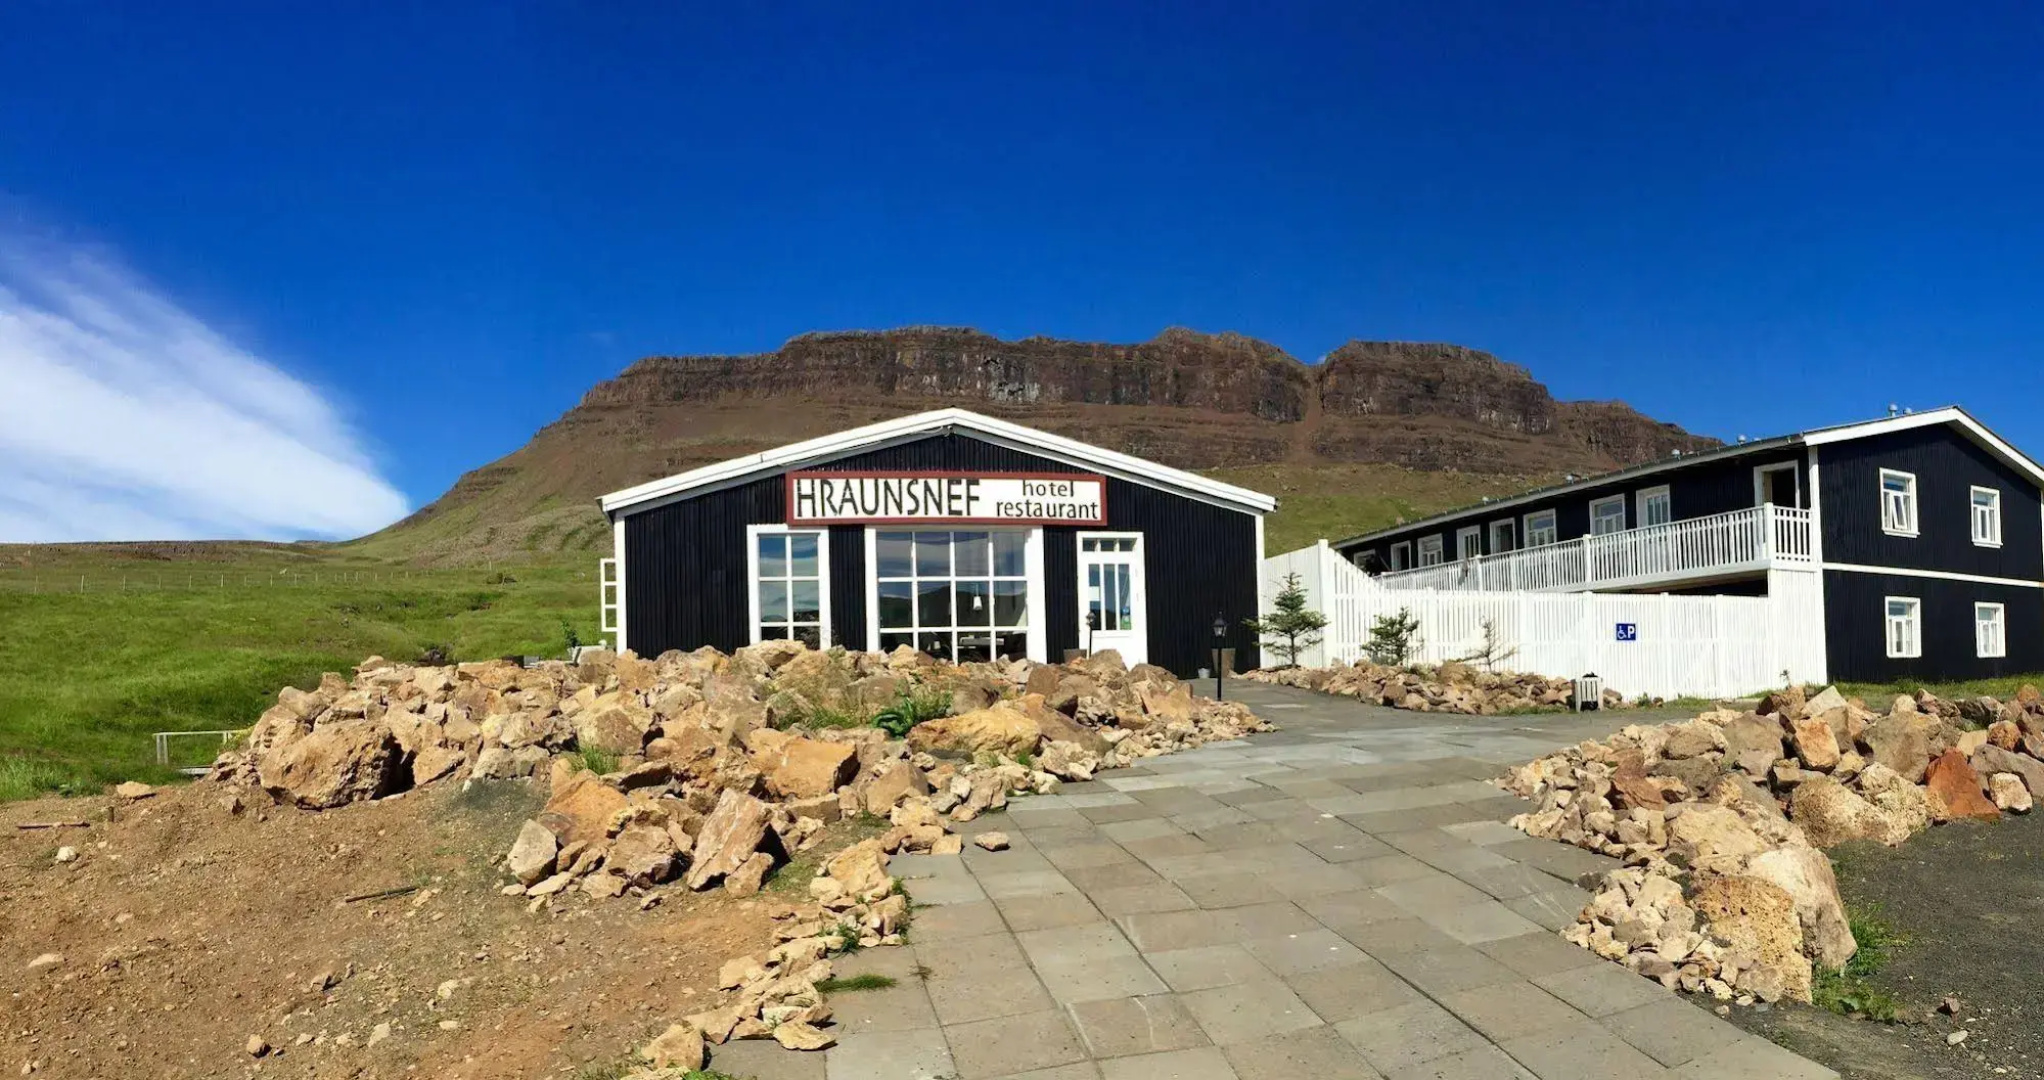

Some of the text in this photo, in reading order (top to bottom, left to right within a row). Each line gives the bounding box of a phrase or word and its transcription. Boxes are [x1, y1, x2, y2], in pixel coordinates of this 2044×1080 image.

[1022, 480, 1075, 497] hotel
[797, 479, 980, 517] HRAUNSNEF
[996, 499, 1099, 519] restaurant
[1627, 625, 1635, 639] P
